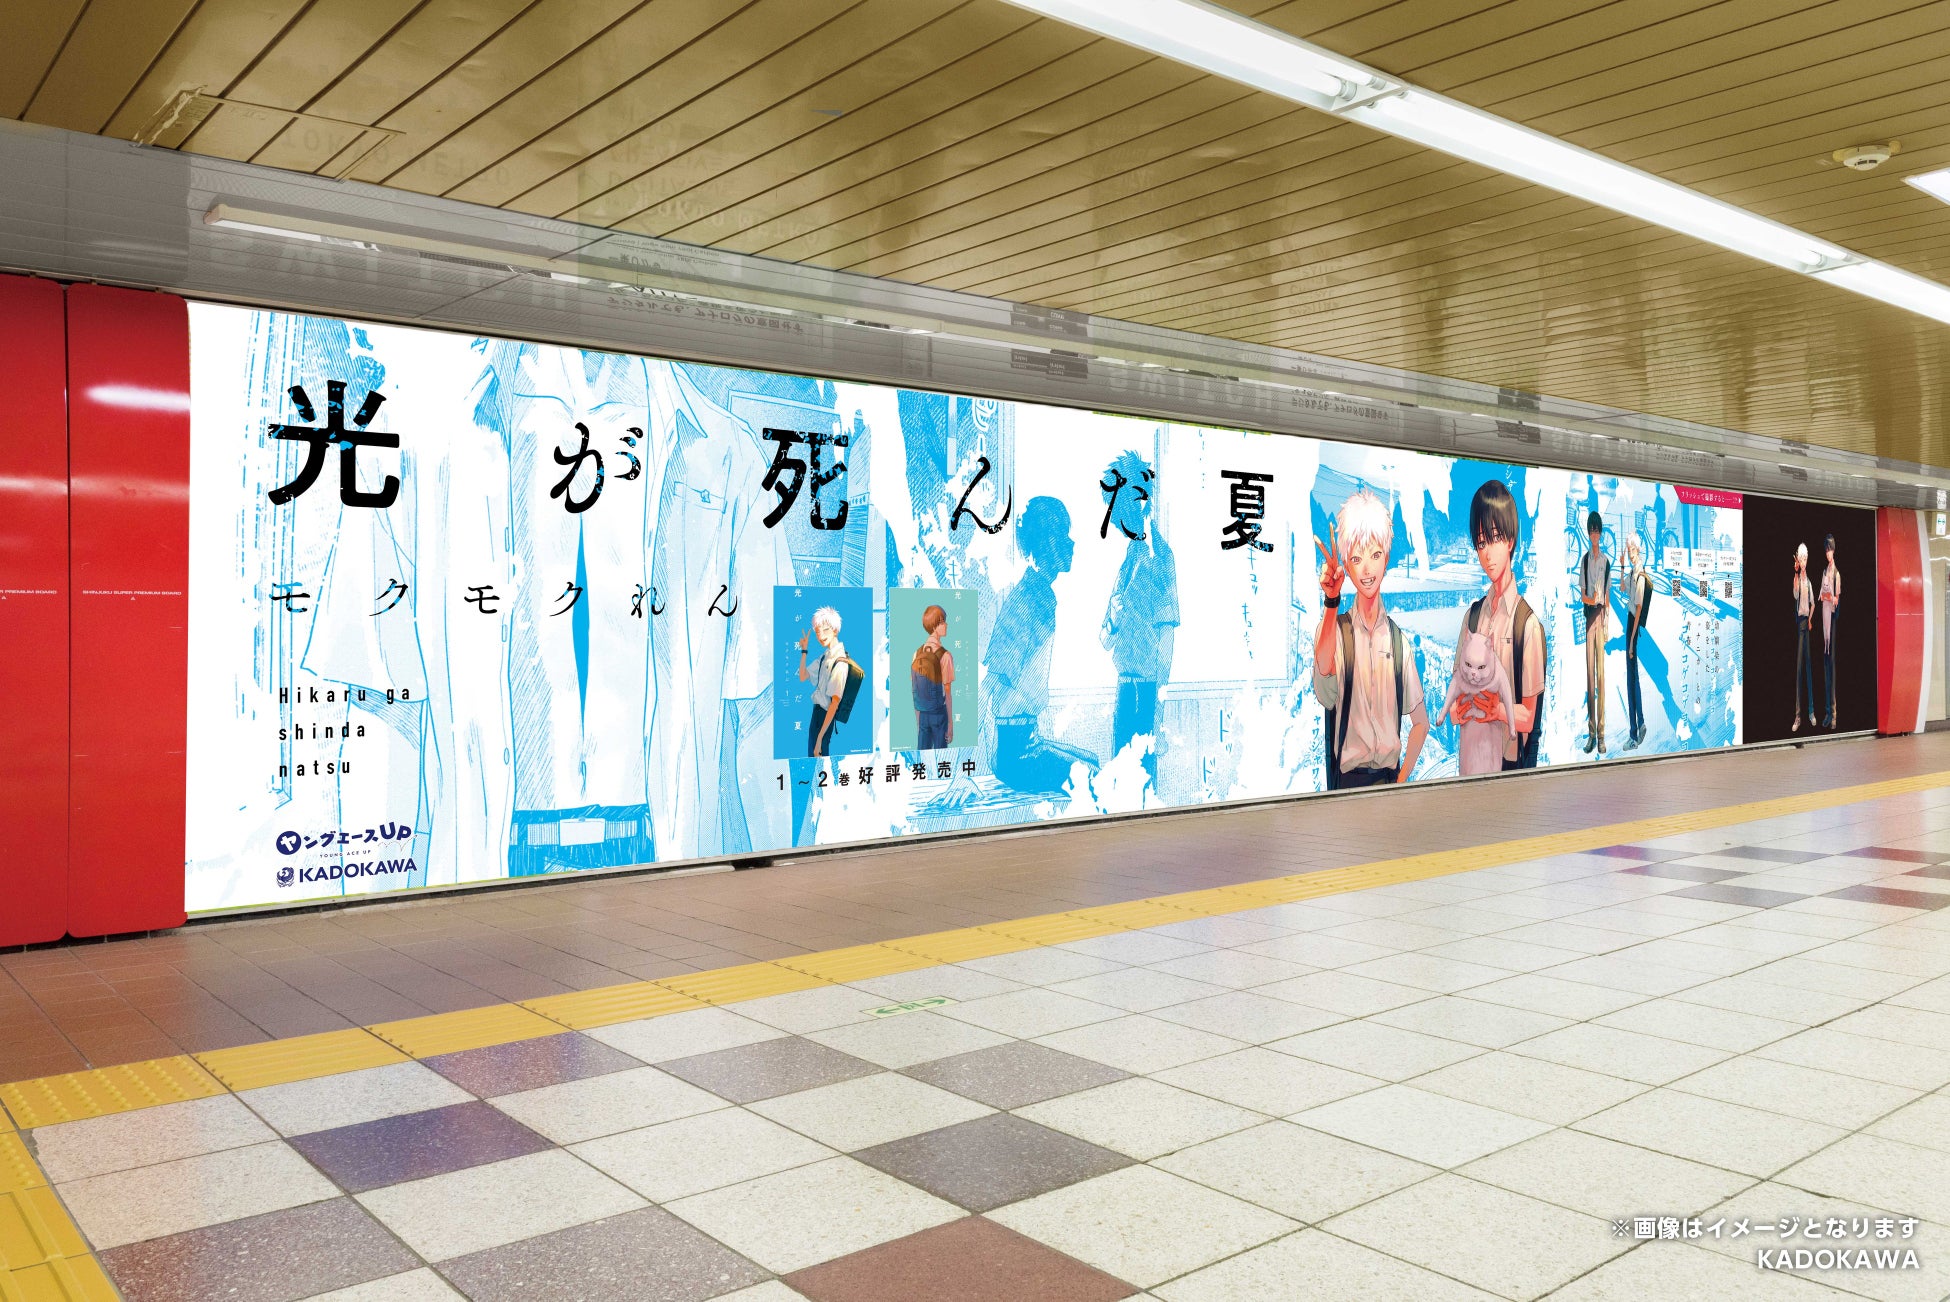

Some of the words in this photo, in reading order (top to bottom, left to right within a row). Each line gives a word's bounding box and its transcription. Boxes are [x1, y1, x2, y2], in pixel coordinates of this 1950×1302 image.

[268, 380, 1274, 553] 光が死んだ夏
[271, 578, 738, 618] モクモクれん
[279, 686, 367, 704] Hikaru
[386, 688, 411, 707] ga
[279, 722, 365, 741] shinda
[279, 761, 350, 778] natsu
[299, 857, 417, 883] KADOKAWA
